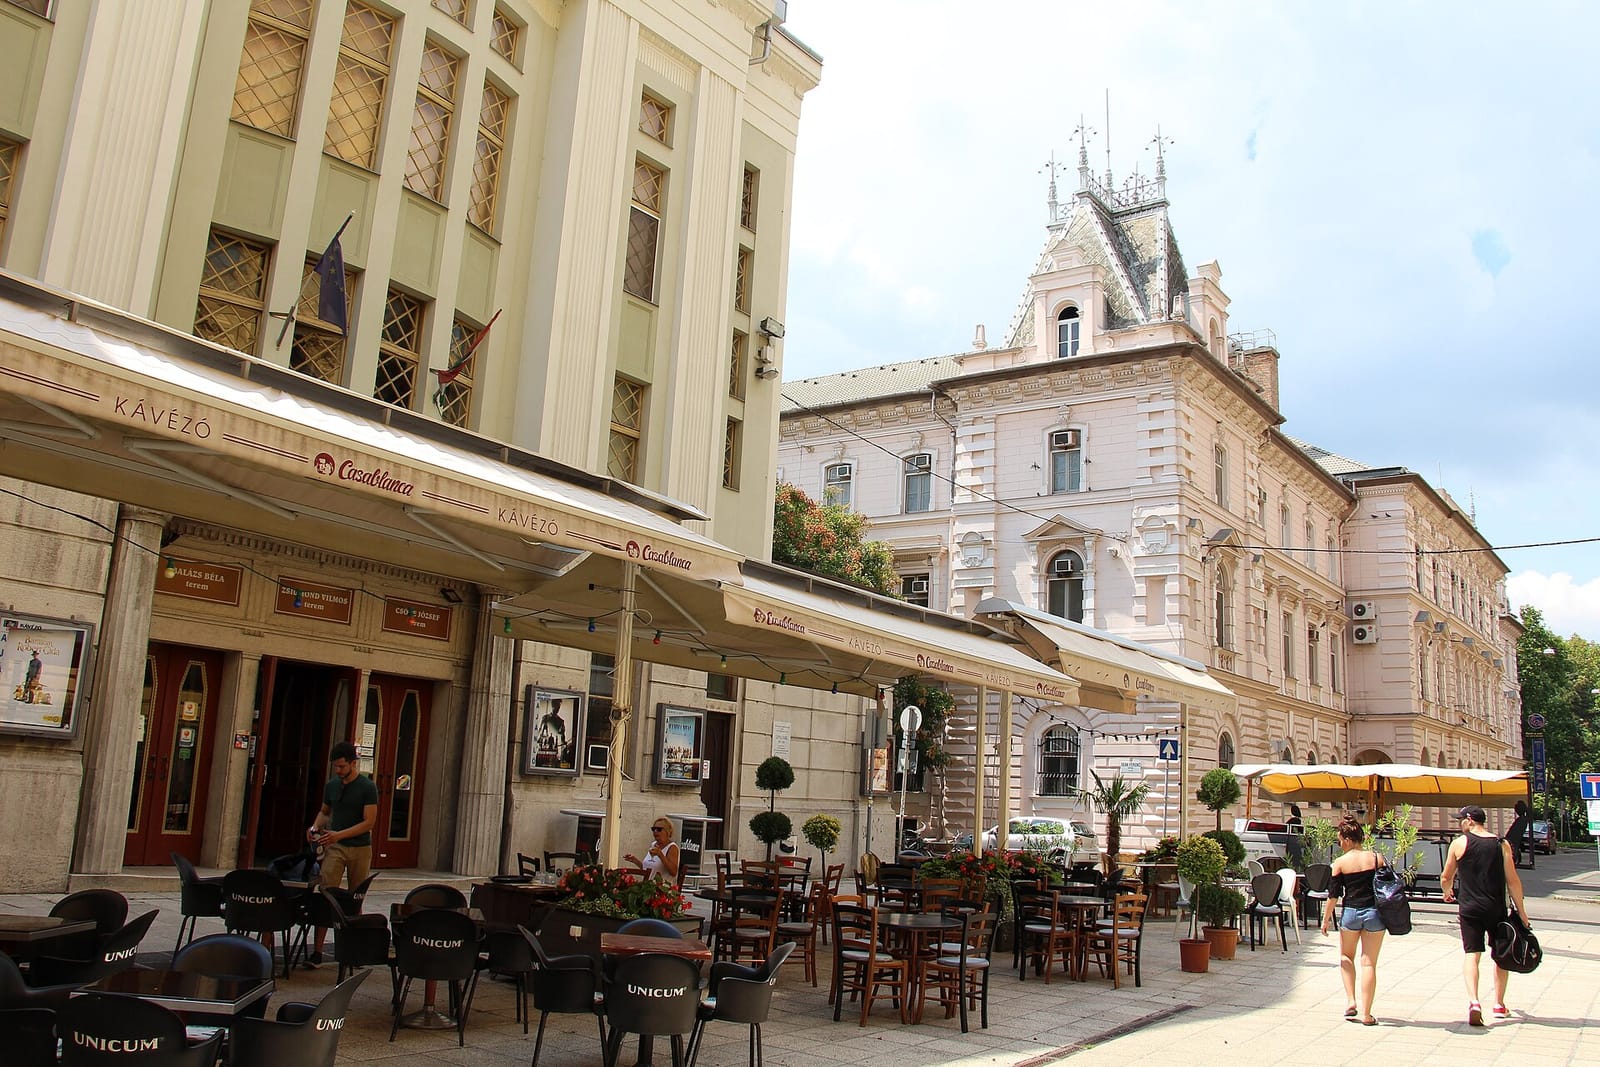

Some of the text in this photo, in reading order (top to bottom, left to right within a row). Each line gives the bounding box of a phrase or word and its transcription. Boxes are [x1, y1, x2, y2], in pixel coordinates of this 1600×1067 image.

[114, 396, 212, 440] KÁVÉZÓ
[338, 460, 414, 496] Casablanca
[498, 508, 559, 536] KÁVÉZÓ
[642, 545, 691, 571] Casablanca
[204, 571, 224, 583] BÉLA
[185, 581, 209, 591] terem
[304, 602, 325, 611] terem
[321, 593, 349, 605] VILMOS
[766, 611, 806, 635] Casablanca
[848, 636, 882, 656] KÁVÉZÓ
[926, 656, 955, 674] Casablanca
[985, 672, 1011, 687] KÁVÉZÓ
[232, 892, 273, 904] UNICUM
[413, 935, 463, 949] UNICUM
[104, 944, 138, 962] UNIC
[627, 983, 685, 998] UNICUM
[316, 1016, 345, 1031] UNIC
[73, 1031, 161, 1053] UNICUM
